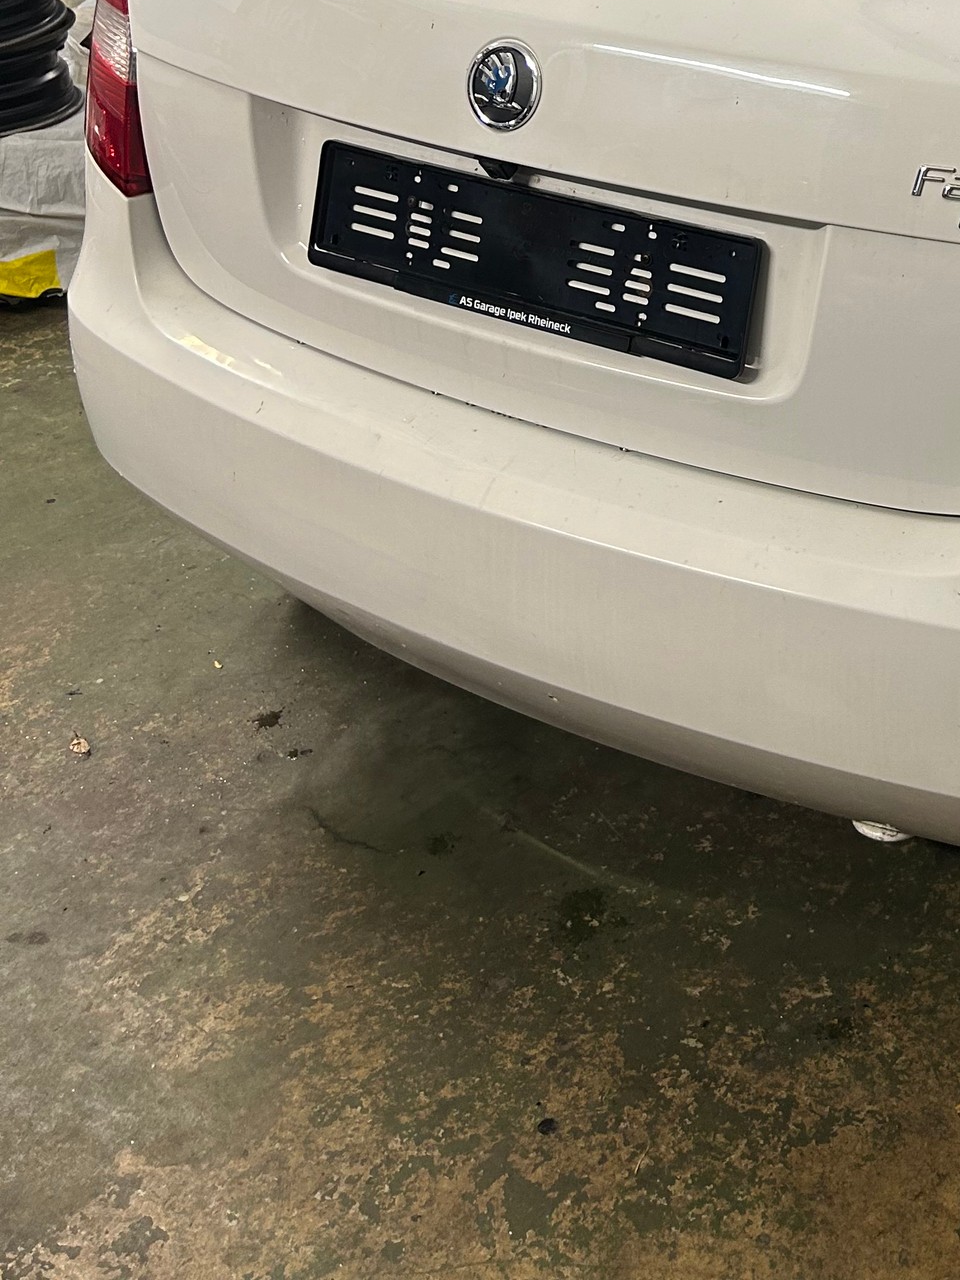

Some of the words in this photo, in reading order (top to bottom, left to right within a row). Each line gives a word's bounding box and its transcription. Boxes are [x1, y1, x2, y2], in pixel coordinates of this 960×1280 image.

[459, 295, 473, 308] AS
[473, 299, 506, 317] Garage
[506, 308, 527, 323] Ipek
[527, 314, 571, 334] Rheineck
